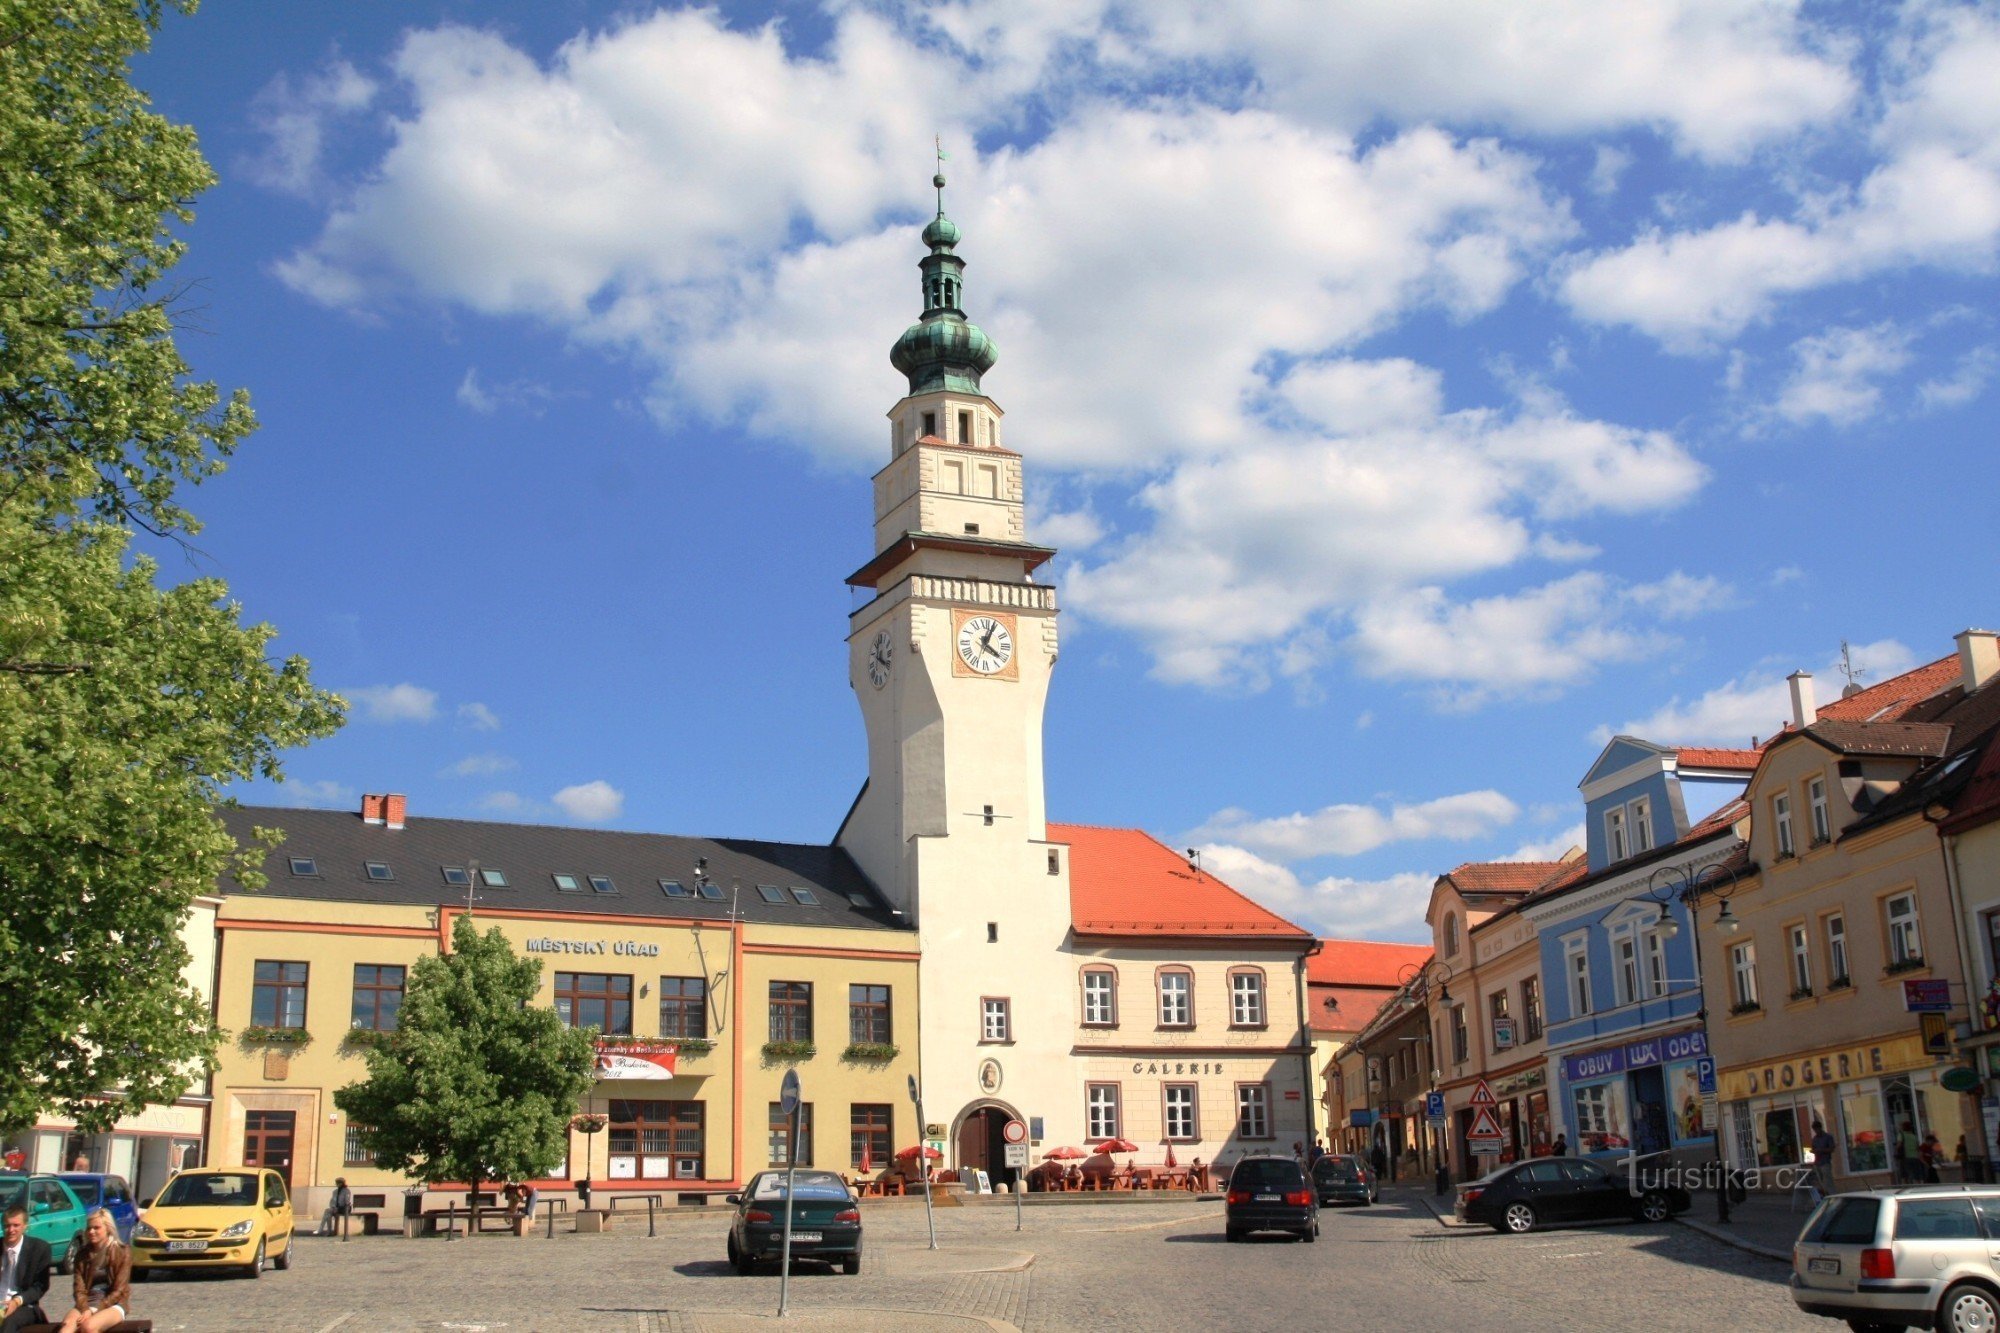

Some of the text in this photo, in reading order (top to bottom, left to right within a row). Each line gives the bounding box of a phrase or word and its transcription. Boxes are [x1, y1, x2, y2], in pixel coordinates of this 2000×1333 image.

[526, 937, 660, 957] MĚSTSKÝ ÚŘAD
[1132, 1062, 1225, 1075] GALERIE
[1578, 1053, 1613, 1077] OBUV
[1630, 1043, 1658, 1065] LUX
[604, 1070, 622, 1078] 2012
[1700, 1061, 1711, 1082] P
[1747, 1047, 1884, 1094] DROGERIE
[1430, 1095, 1440, 1109] P
